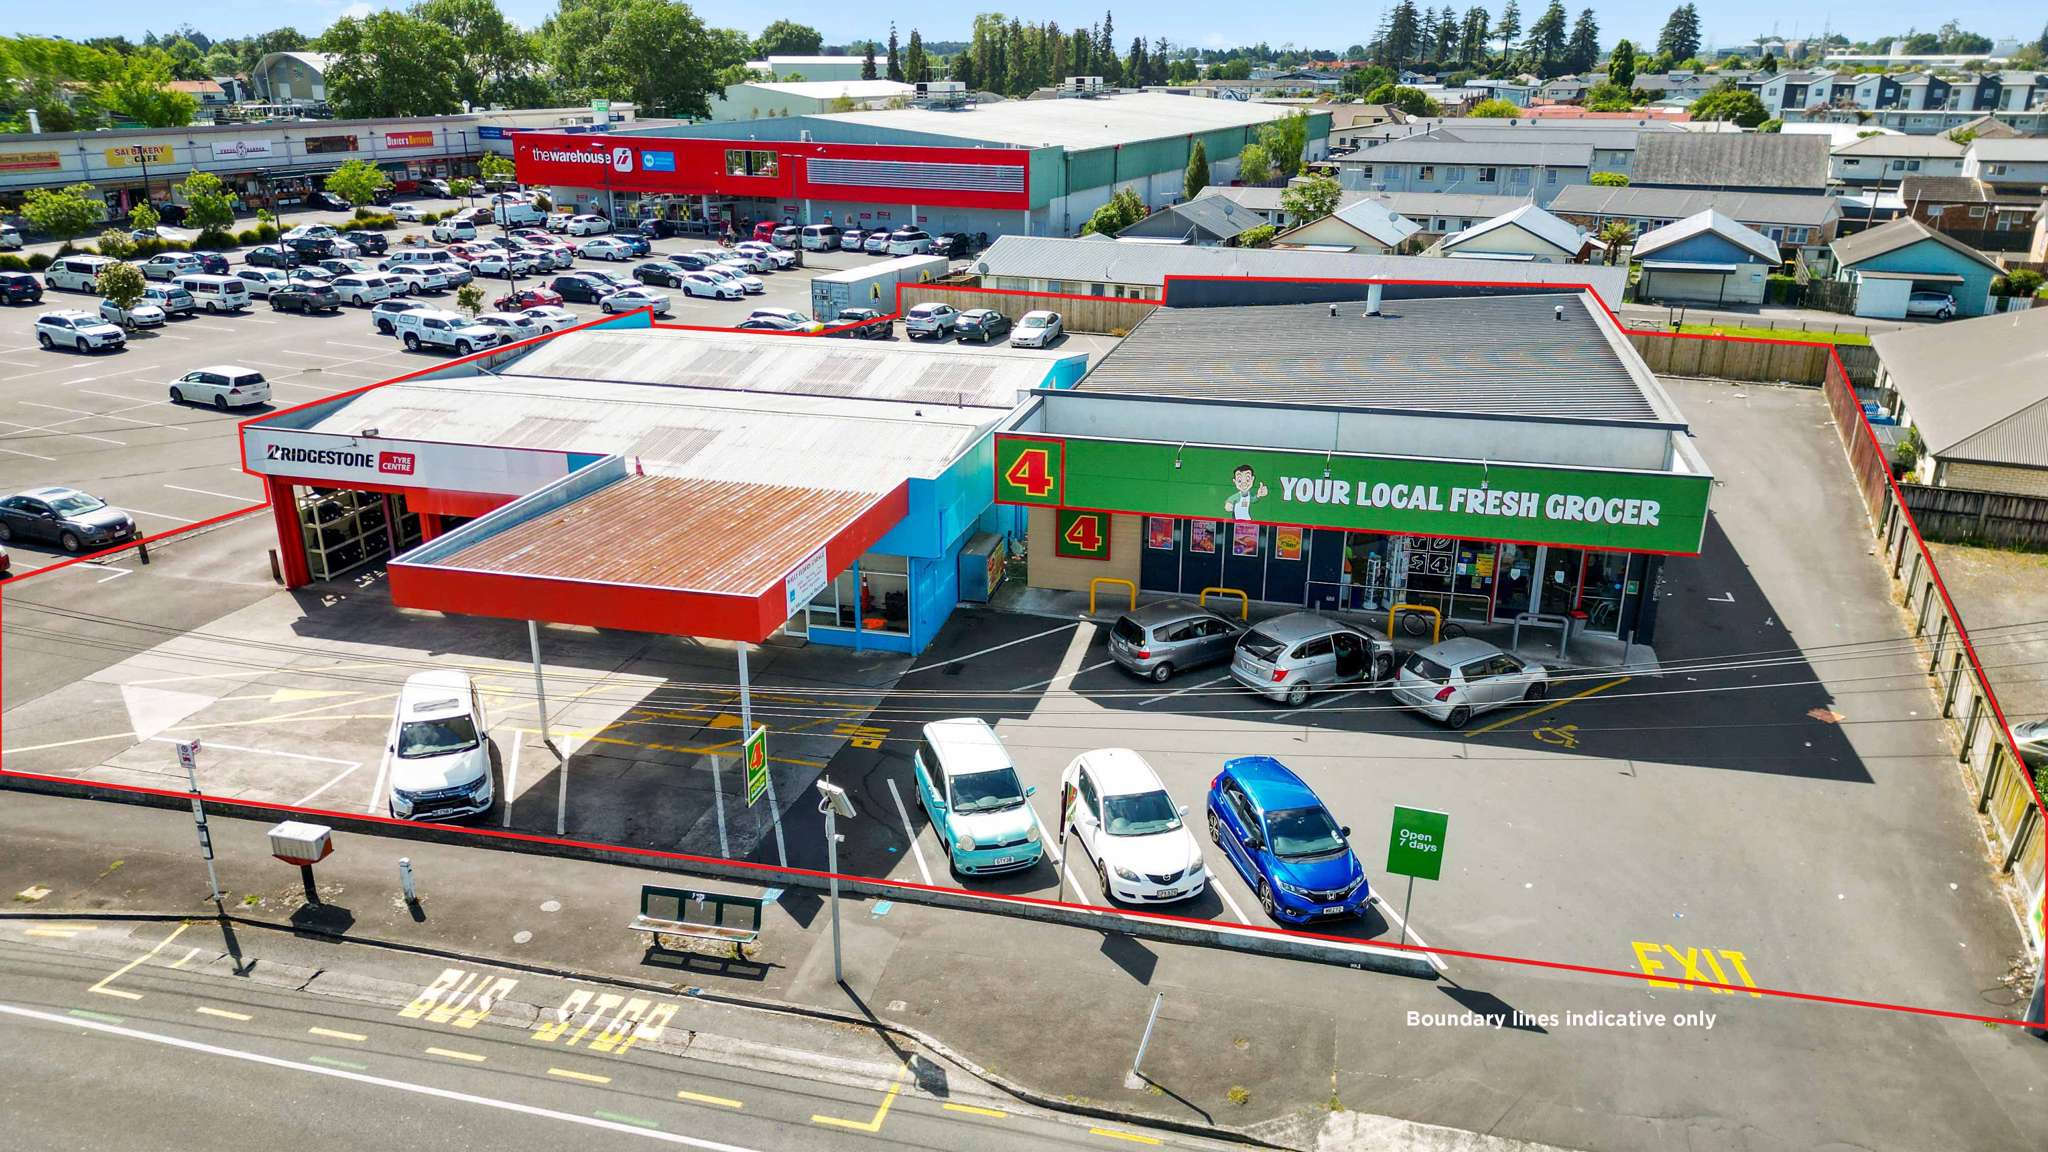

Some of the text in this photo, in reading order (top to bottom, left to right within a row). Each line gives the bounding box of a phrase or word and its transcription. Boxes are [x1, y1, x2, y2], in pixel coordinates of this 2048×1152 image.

[267, 444, 374, 468] BRIDGESTONE
[382, 462, 411, 472] CENTRE
[393, 456, 411, 465] TYRE
[1005, 449, 1053, 497] 4
[1280, 476, 1661, 527] YOUR LOCAL FRESH GROCER
[1065, 515, 1102, 551] 4
[750, 740, 764, 770] 4
[1399, 838, 1437, 852] 7 days
[1400, 829, 1432, 842] Open
[1631, 941, 1762, 998] EXIT
[397, 968, 680, 1055] BUS STOP
